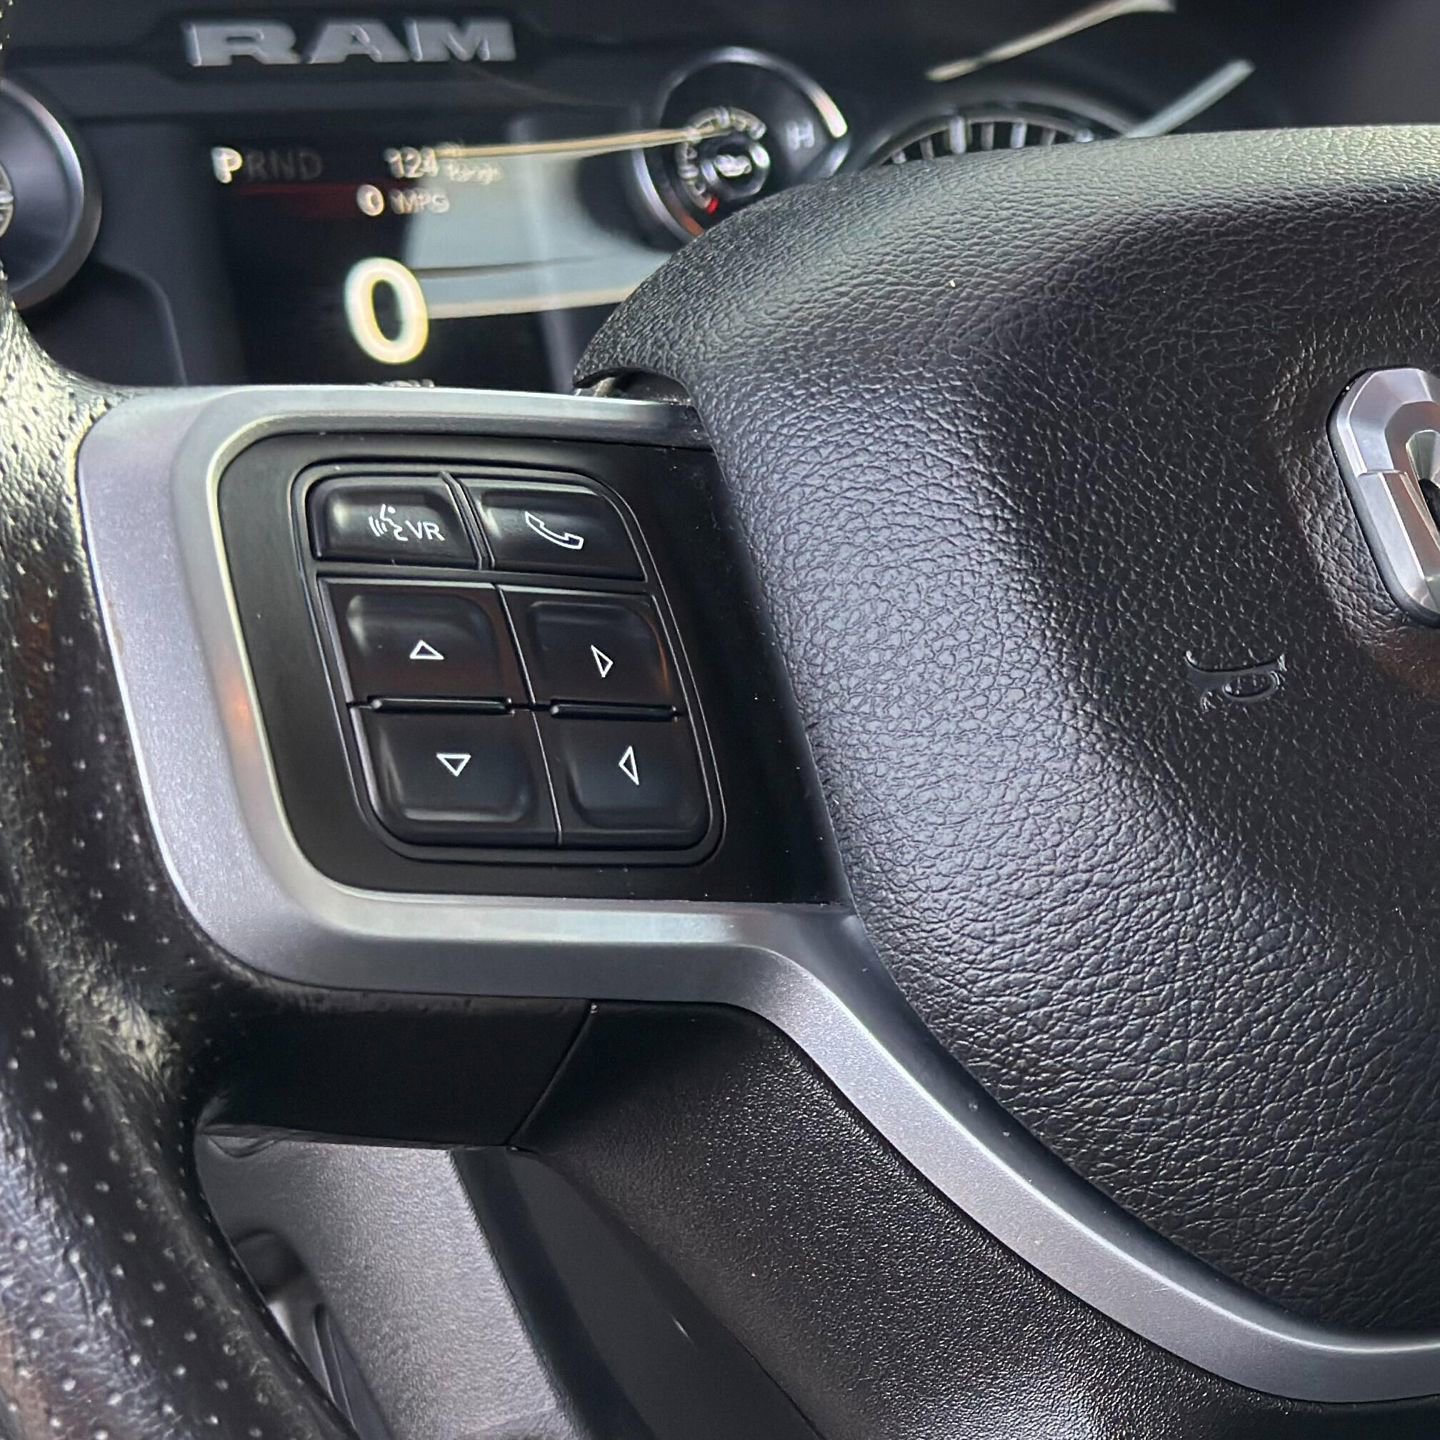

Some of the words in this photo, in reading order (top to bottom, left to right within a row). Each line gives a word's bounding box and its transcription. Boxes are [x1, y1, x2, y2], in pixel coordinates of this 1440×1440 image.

[180, 18, 517, 67] RAM
[343, 256, 429, 365] 0
[405, 520, 446, 541] VR
